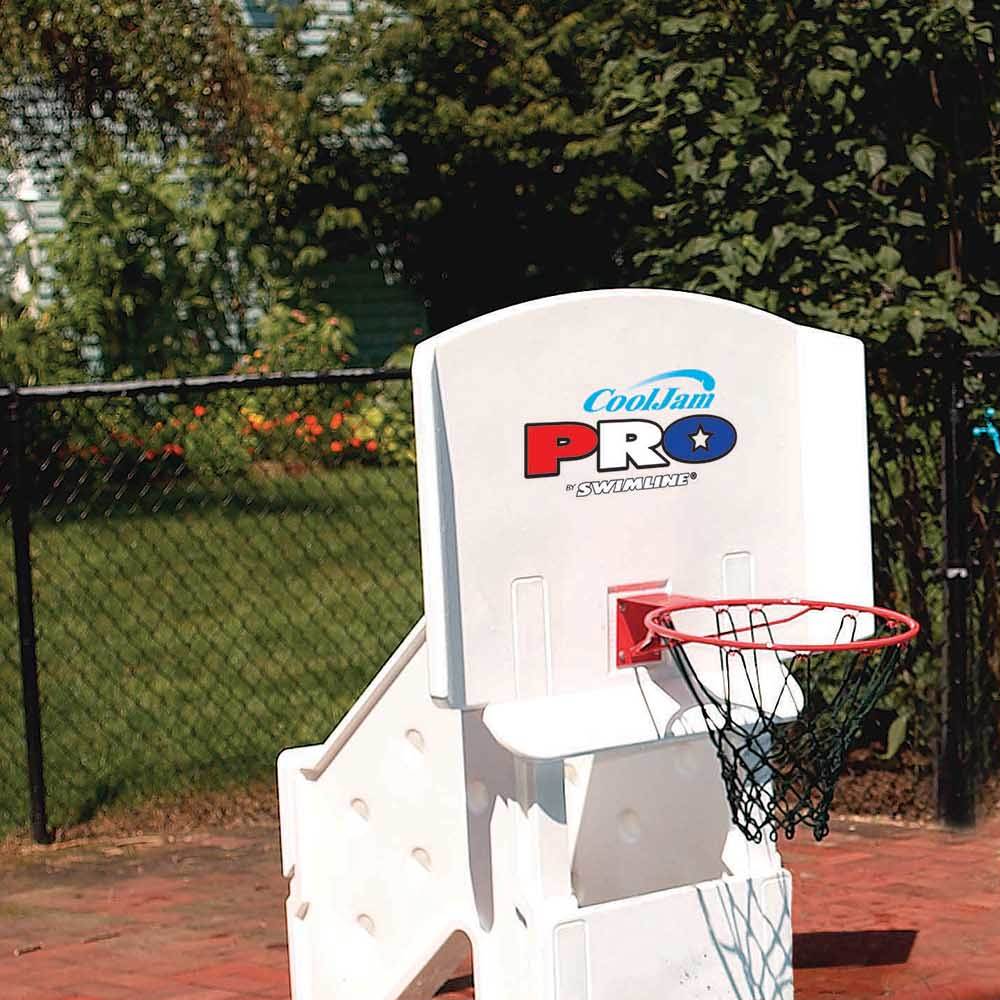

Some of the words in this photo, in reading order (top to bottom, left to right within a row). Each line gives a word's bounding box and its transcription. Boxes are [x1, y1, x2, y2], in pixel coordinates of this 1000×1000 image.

[583, 387, 715, 413] CoolJam
[524, 414, 737, 479] PRO
[566, 484, 576, 492] BY
